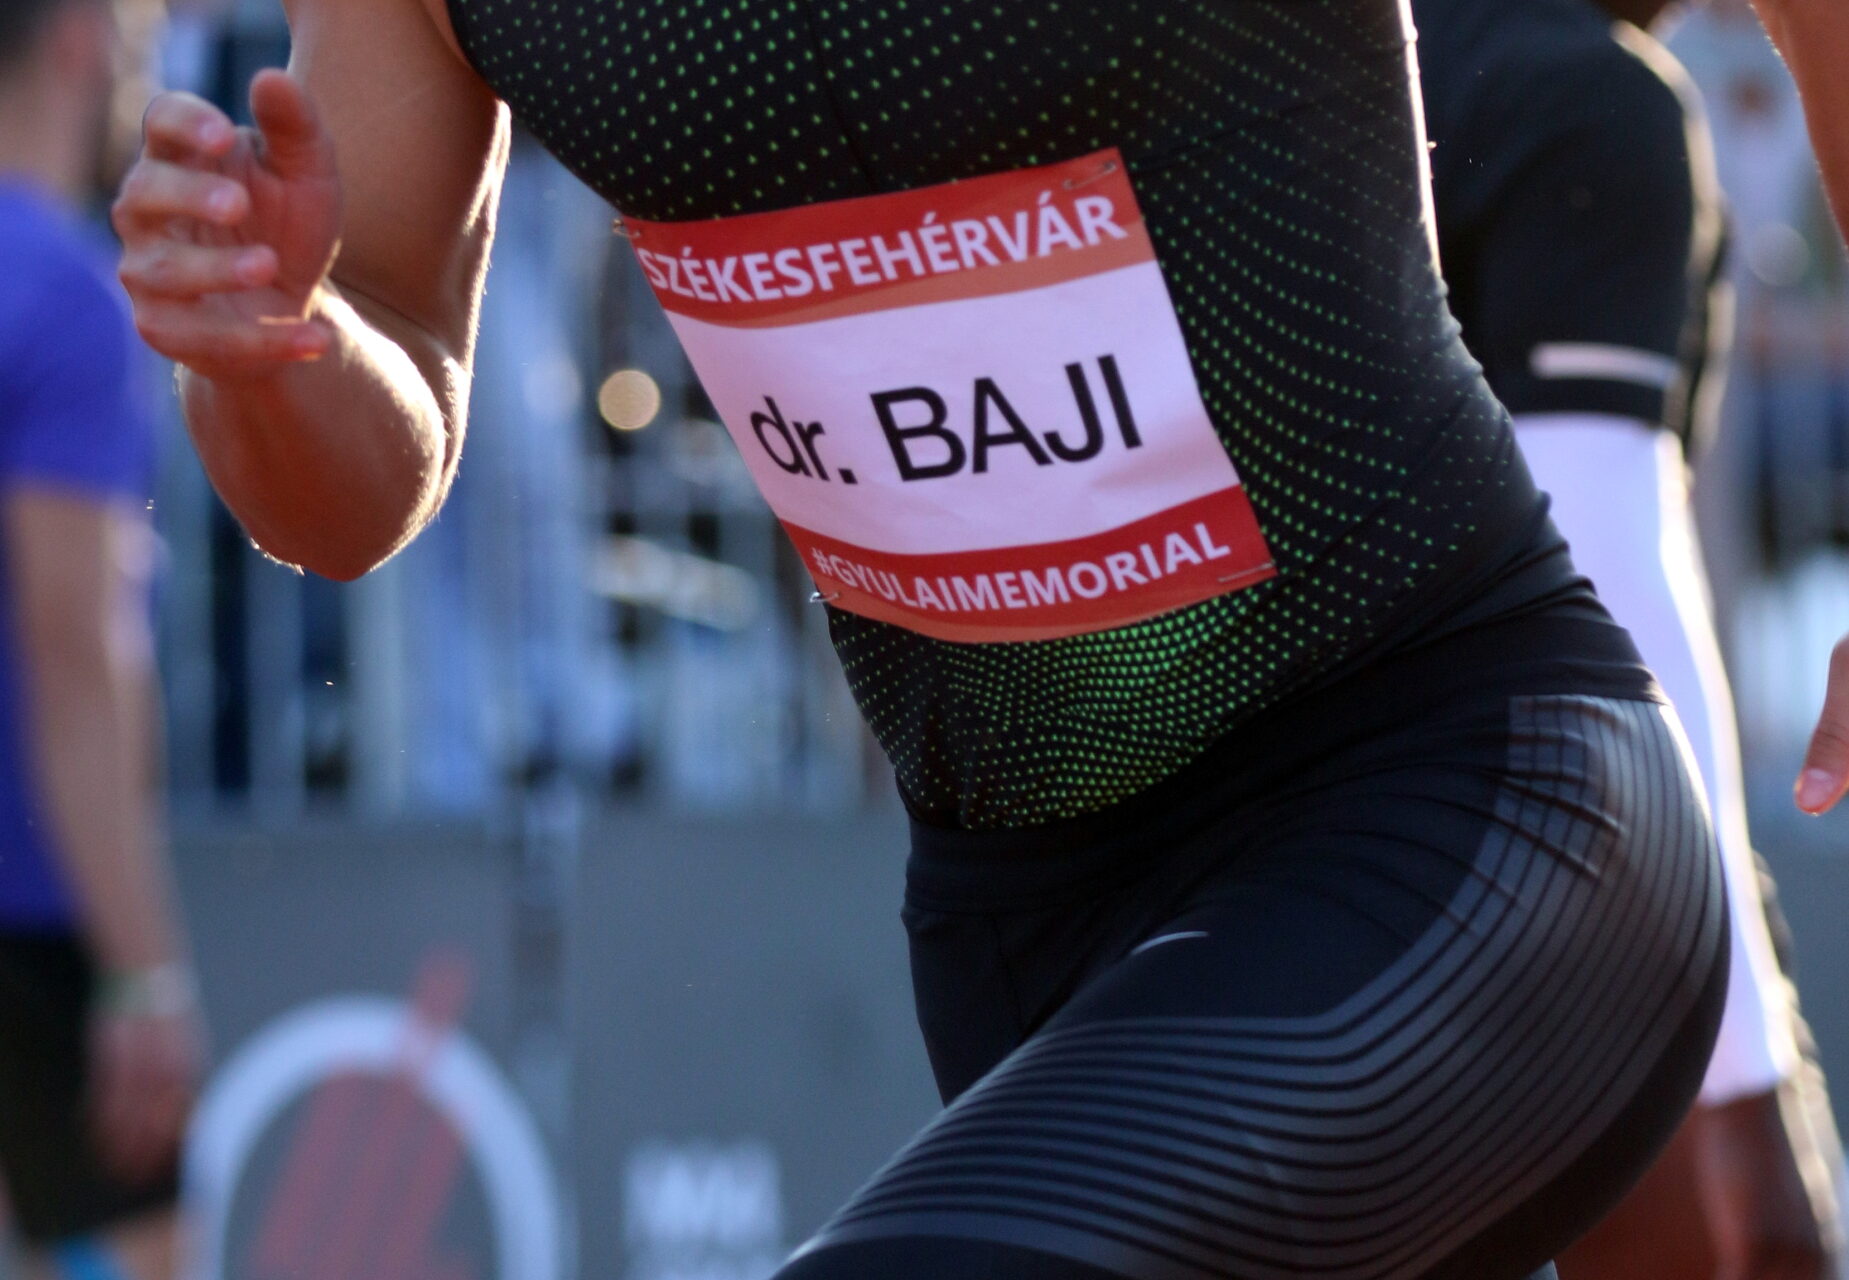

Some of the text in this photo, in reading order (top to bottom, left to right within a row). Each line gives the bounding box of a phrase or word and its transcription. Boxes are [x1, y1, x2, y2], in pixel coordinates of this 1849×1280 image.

[637, 191, 1128, 303] SZÉKESFEHÉRVÁR
[749, 354, 1143, 485] dr. BAJI
[812, 523, 1231, 612] #GYULAIMEMORIAL
